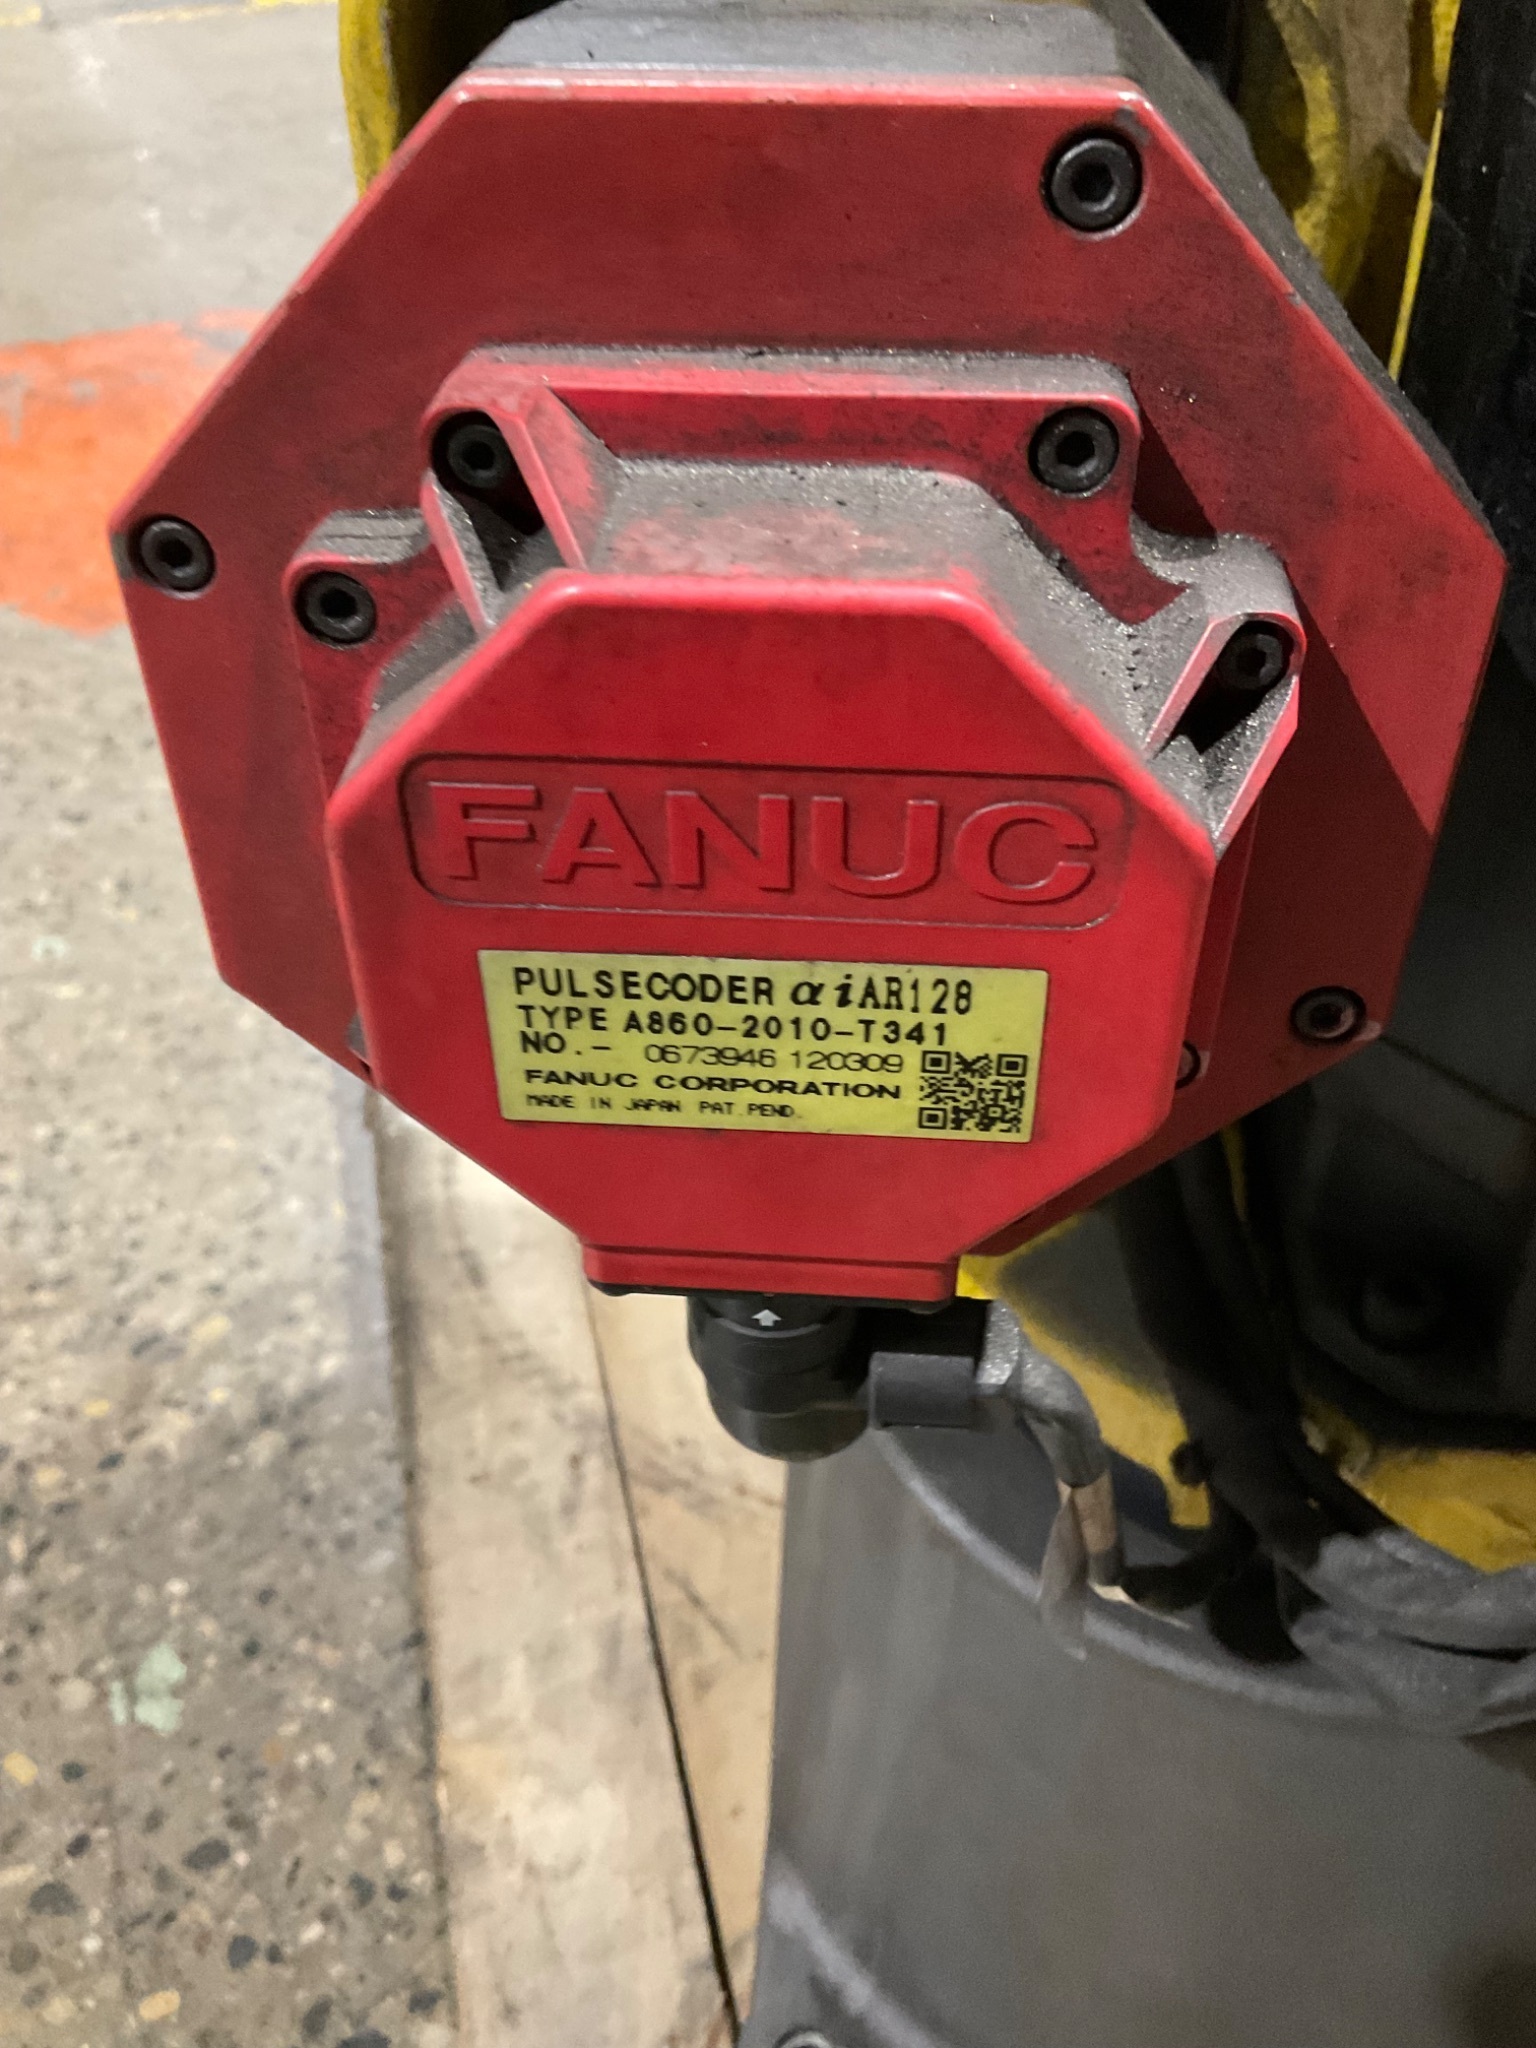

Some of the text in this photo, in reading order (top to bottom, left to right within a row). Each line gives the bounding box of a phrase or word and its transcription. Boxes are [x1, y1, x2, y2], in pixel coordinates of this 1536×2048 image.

[427, 781, 1099, 904] FANUC
[513, 967, 774, 1006] PULSECODER
[517, 1004, 947, 1045] TYPE A860-2010-T341
[790, 1050, 904, 1073] 120309
[525, 1069, 902, 1099] FANUC CORPORATION
[526, 1094, 575, 1108] MADE
[591, 1097, 613, 1110] IN
[625, 1098, 683, 1113] JAPAN
